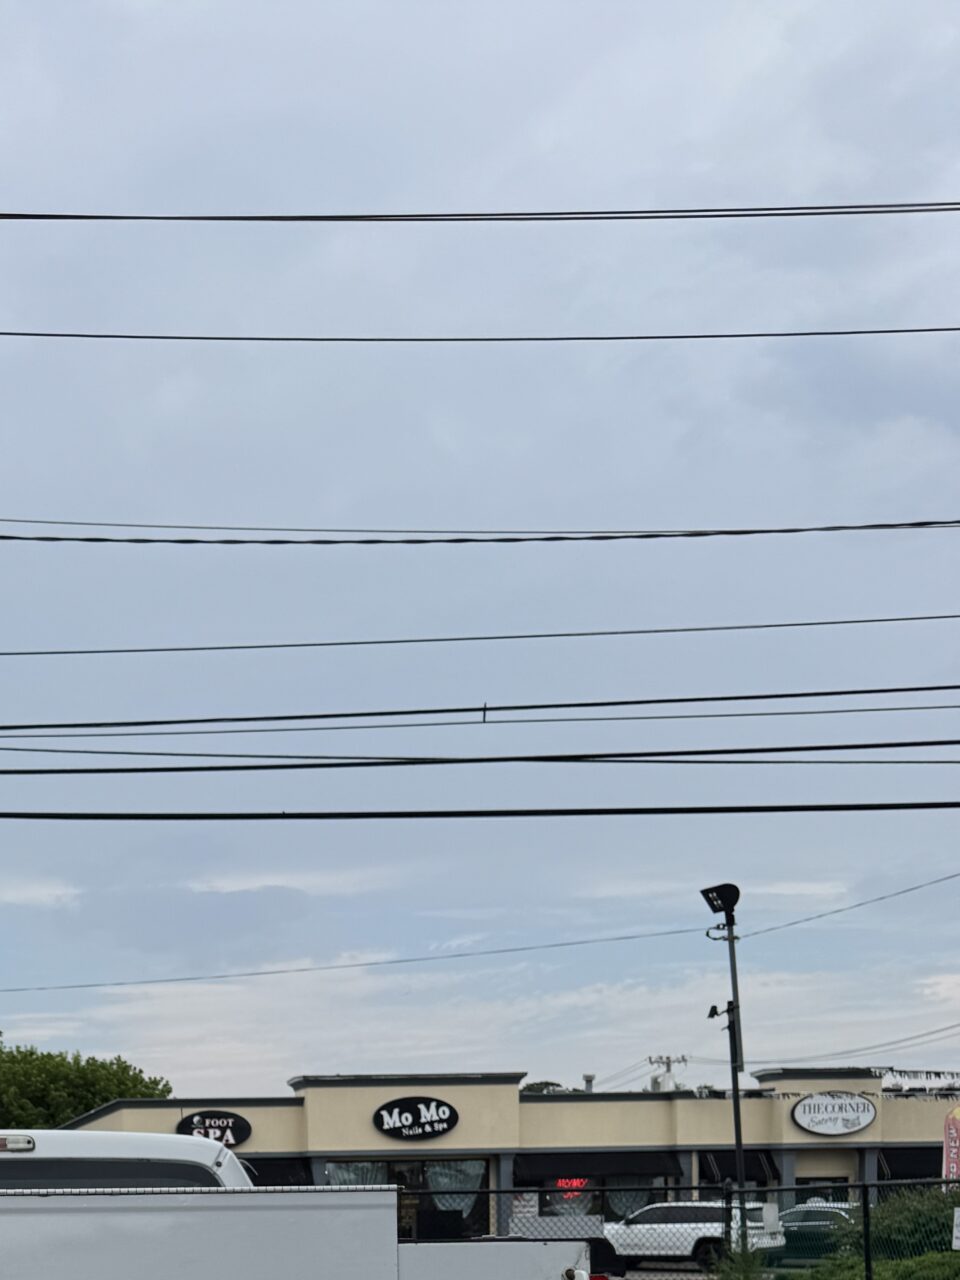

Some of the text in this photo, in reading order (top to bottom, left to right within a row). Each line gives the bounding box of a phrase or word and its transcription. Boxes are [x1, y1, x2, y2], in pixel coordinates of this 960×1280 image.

[802, 1102, 870, 1114] THE CORNER
[380, 1101, 450, 1130] Mo Mo
[205, 1118, 234, 1127] FOOT
[401, 1121, 448, 1136] Nails & Spa
